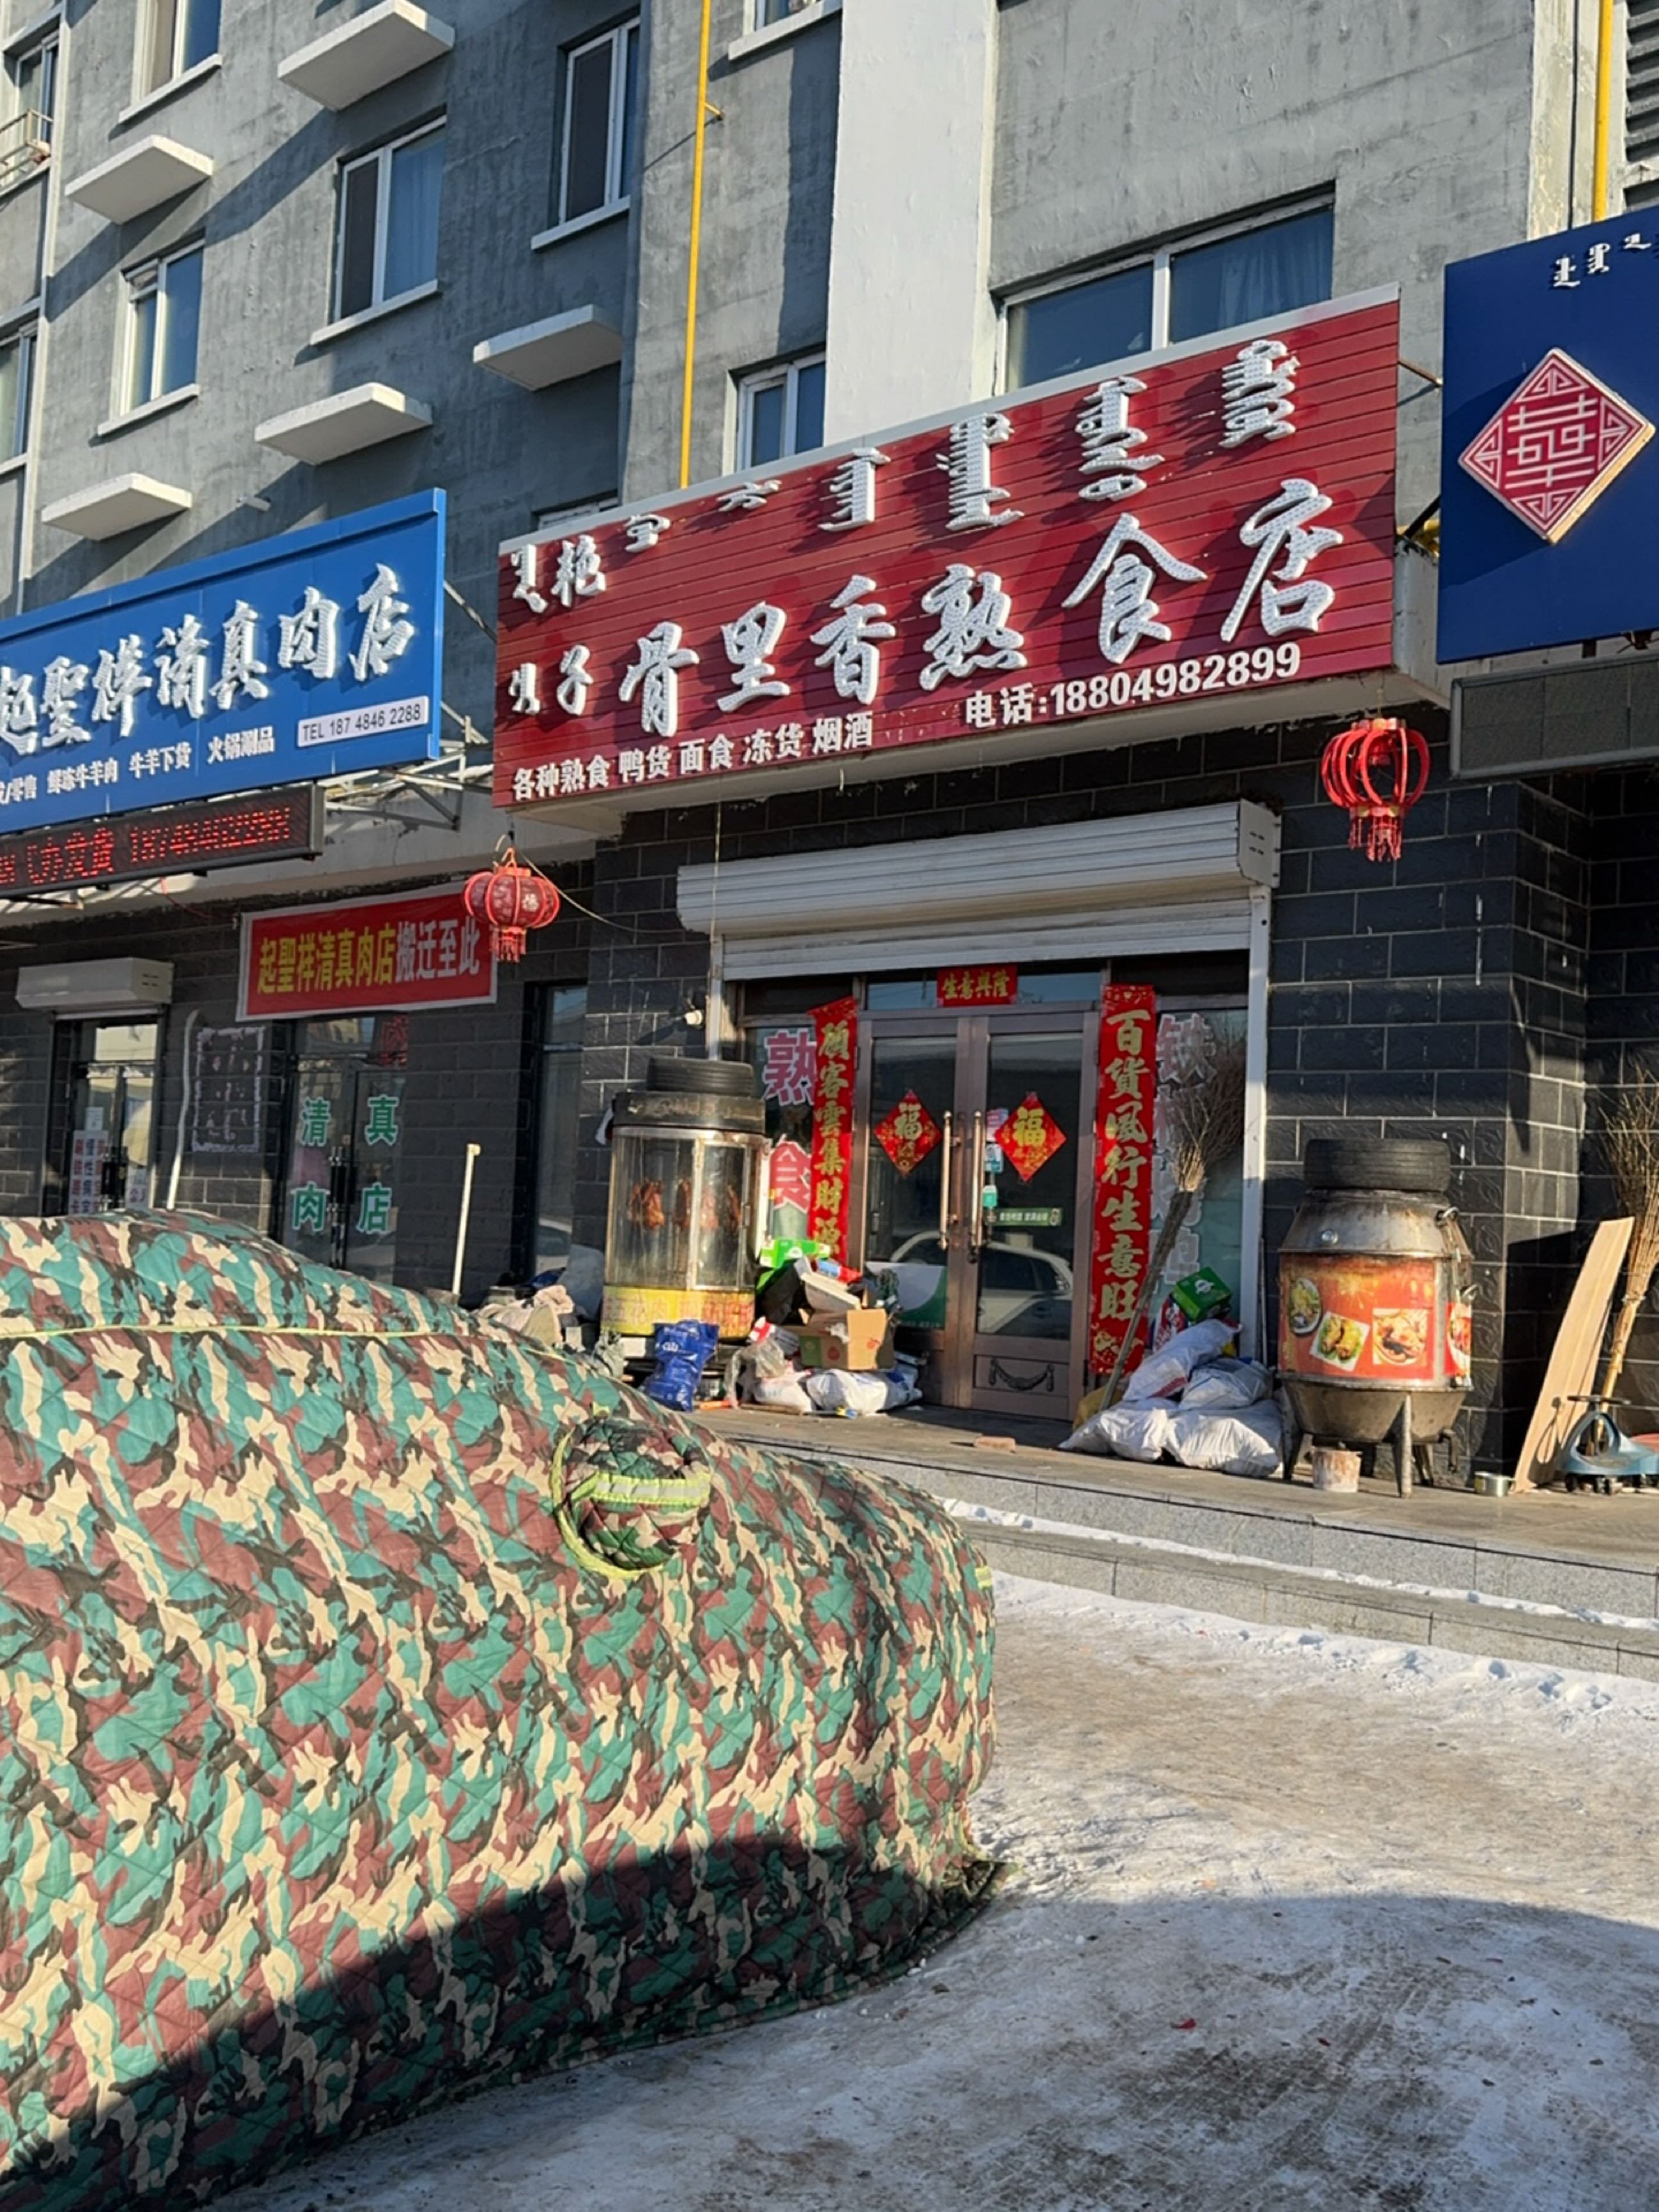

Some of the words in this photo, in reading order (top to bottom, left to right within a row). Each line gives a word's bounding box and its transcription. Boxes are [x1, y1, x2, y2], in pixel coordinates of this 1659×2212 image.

[619, 479, 1343, 737] 骨里香熟食店
[965, 643, 1301, 730] 电话:18804982899
[302, 723, 325, 742] TEL
[330, 717, 351, 736] 187
[355, 710, 385, 732] 4846
[389, 703, 421, 725] 2288
[513, 756, 611, 802] 各种熟食
[619, 746, 670, 783] 鸭货
[679, 733, 735, 774] 面食
[742, 723, 805, 765] 冻货
[812, 710, 874, 754] 烟酒
[894, 1102, 922, 1142] 福
[1013, 1107, 1046, 1147] 福
